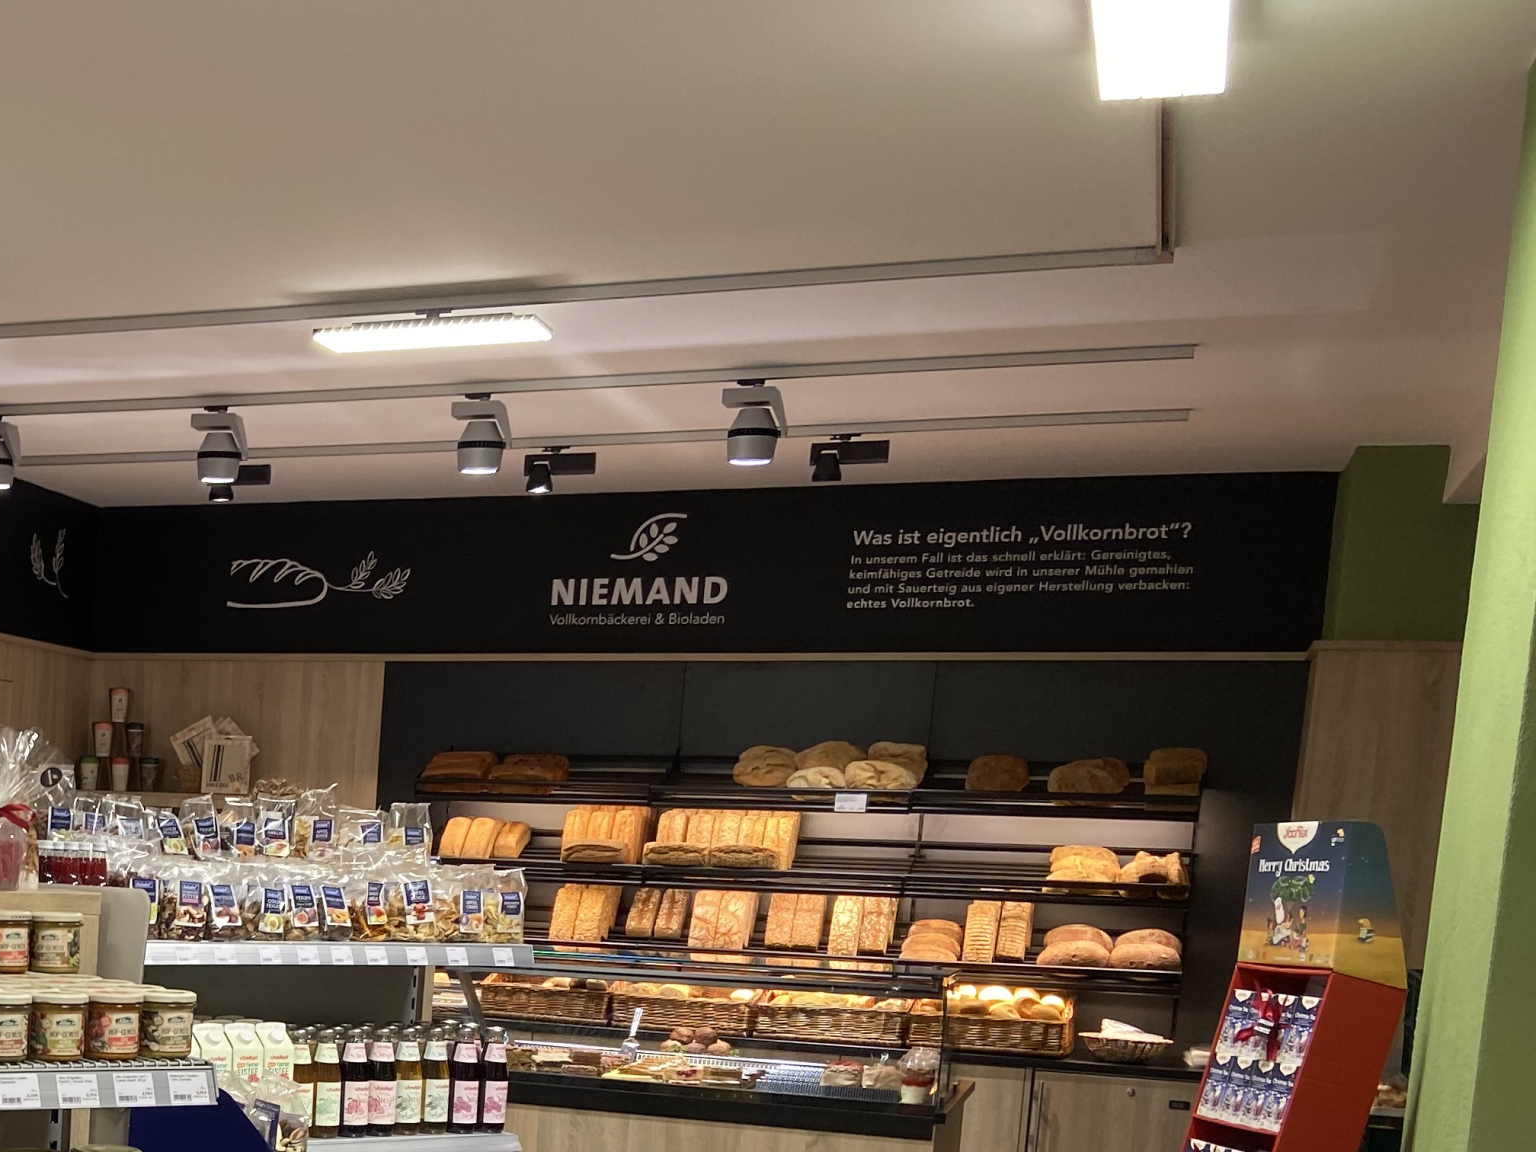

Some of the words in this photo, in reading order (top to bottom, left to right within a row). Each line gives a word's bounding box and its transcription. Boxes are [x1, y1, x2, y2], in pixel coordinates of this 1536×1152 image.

[853, 530, 892, 546] Was
[898, 529, 921, 545] ist
[926, 525, 1022, 548] eigentlich
[850, 554, 862, 565] In
[866, 554, 918, 565] unserem
[921, 552, 944, 564] Fall
[947, 552, 963, 564] ist
[966, 551, 988, 563] das
[992, 550, 1036, 563] schnell
[1039, 550, 1086, 563] erklärt:
[1091, 549, 1171, 563] Gereinigtes,
[849, 567, 922, 581] keimfähiges
[926, 566, 981, 579] Getreide
[985, 566, 1013, 578] wird
[1016, 566, 1028, 577] in
[1032, 566, 1080, 577] unserer
[1085, 564, 1125, 576] Mühle
[1129, 562, 1194, 578] gemahlen
[550, 576, 729, 606] NIEMAND
[847, 583, 871, 595] und
[874, 582, 894, 594] mit
[897, 582, 957, 596] Sauerteig
[961, 583, 982, 594] aus
[986, 582, 1034, 595] eigener
[1038, 580, 1114, 594] Herstellung
[846, 598, 887, 609] echtes
[891, 597, 975, 609] Vollkornbrot.
[549, 613, 651, 626] Vollkornbäckerei
[654, 612, 664, 626] &
[668, 612, 725, 625] Bioladen
[1259, 859, 1283, 877] Merry
[1284, 858, 1330, 872] Christmas
